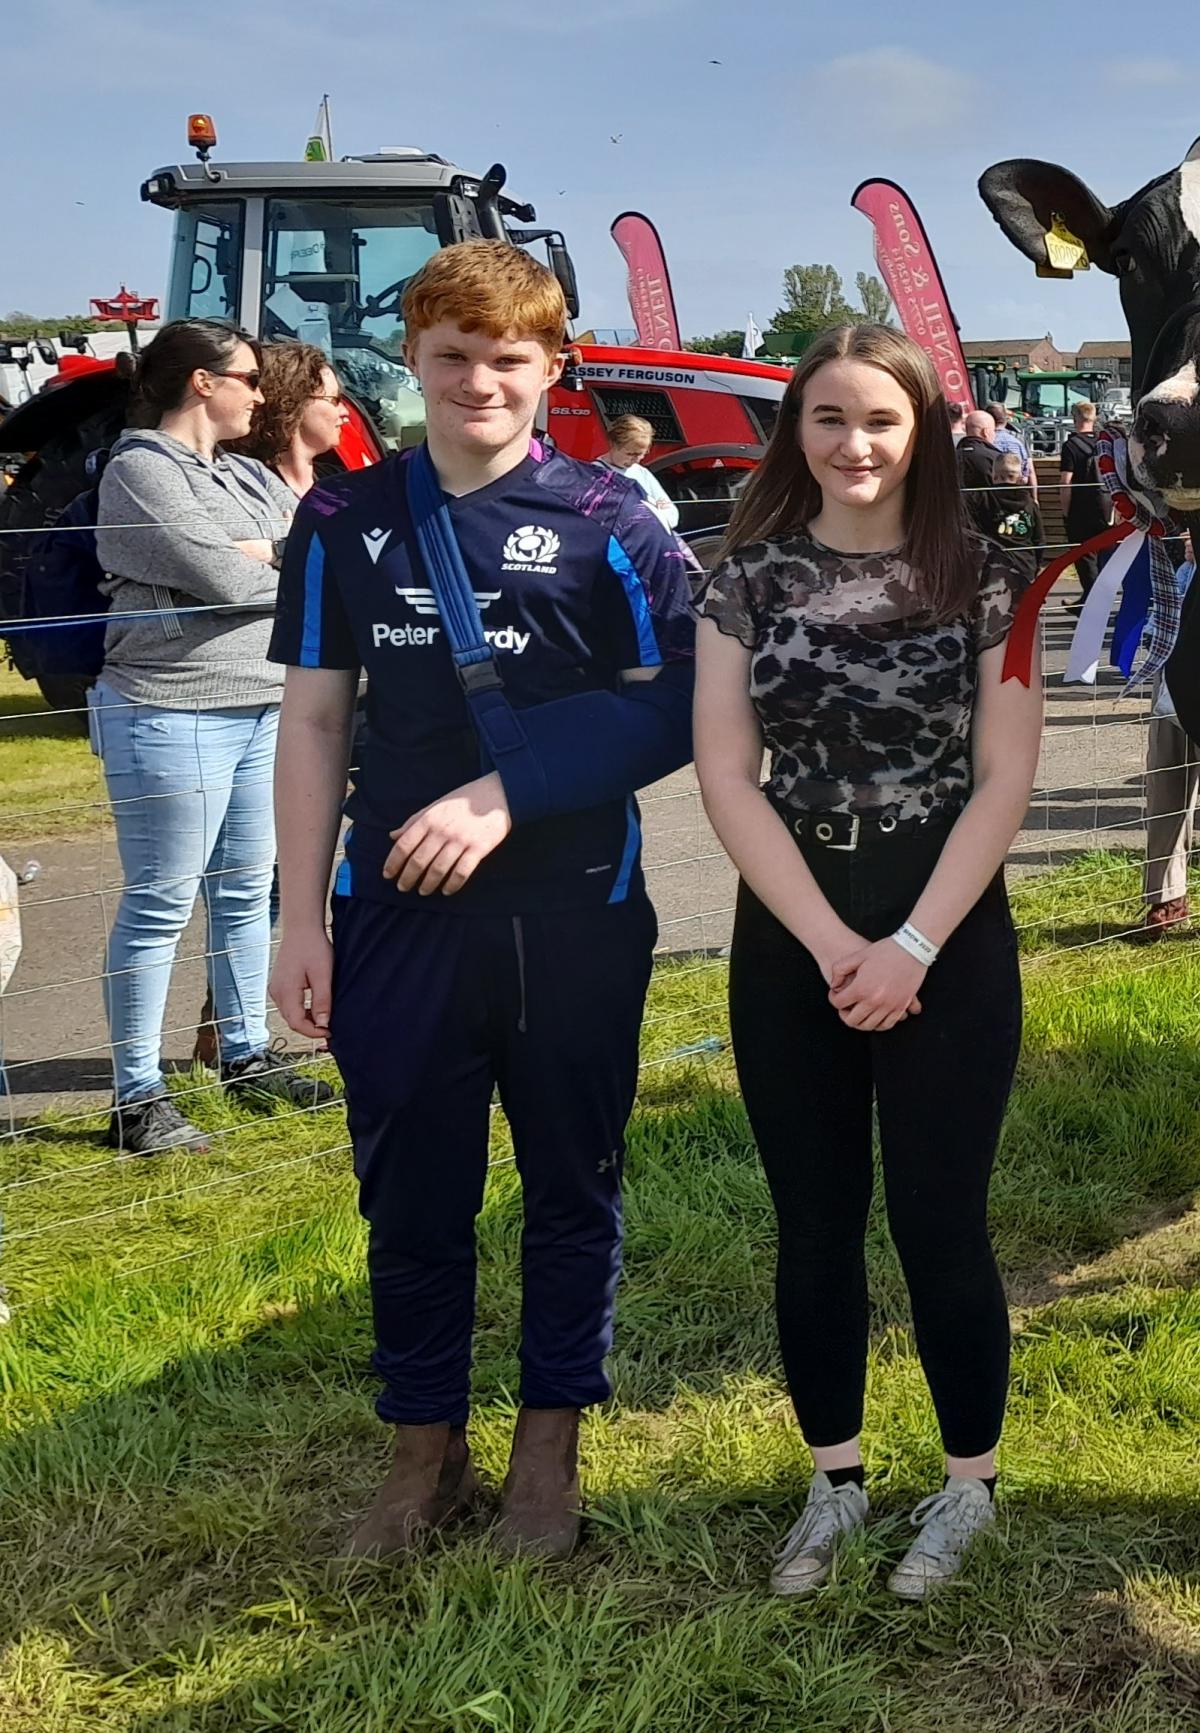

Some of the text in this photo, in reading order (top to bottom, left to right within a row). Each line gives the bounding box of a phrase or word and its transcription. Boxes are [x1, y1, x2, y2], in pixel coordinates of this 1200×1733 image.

[567, 367, 695, 384] ASSEY FERGUSON
[501, 563, 558, 574] SCOTLAND
[372, 623, 531, 655] Peter rdy
